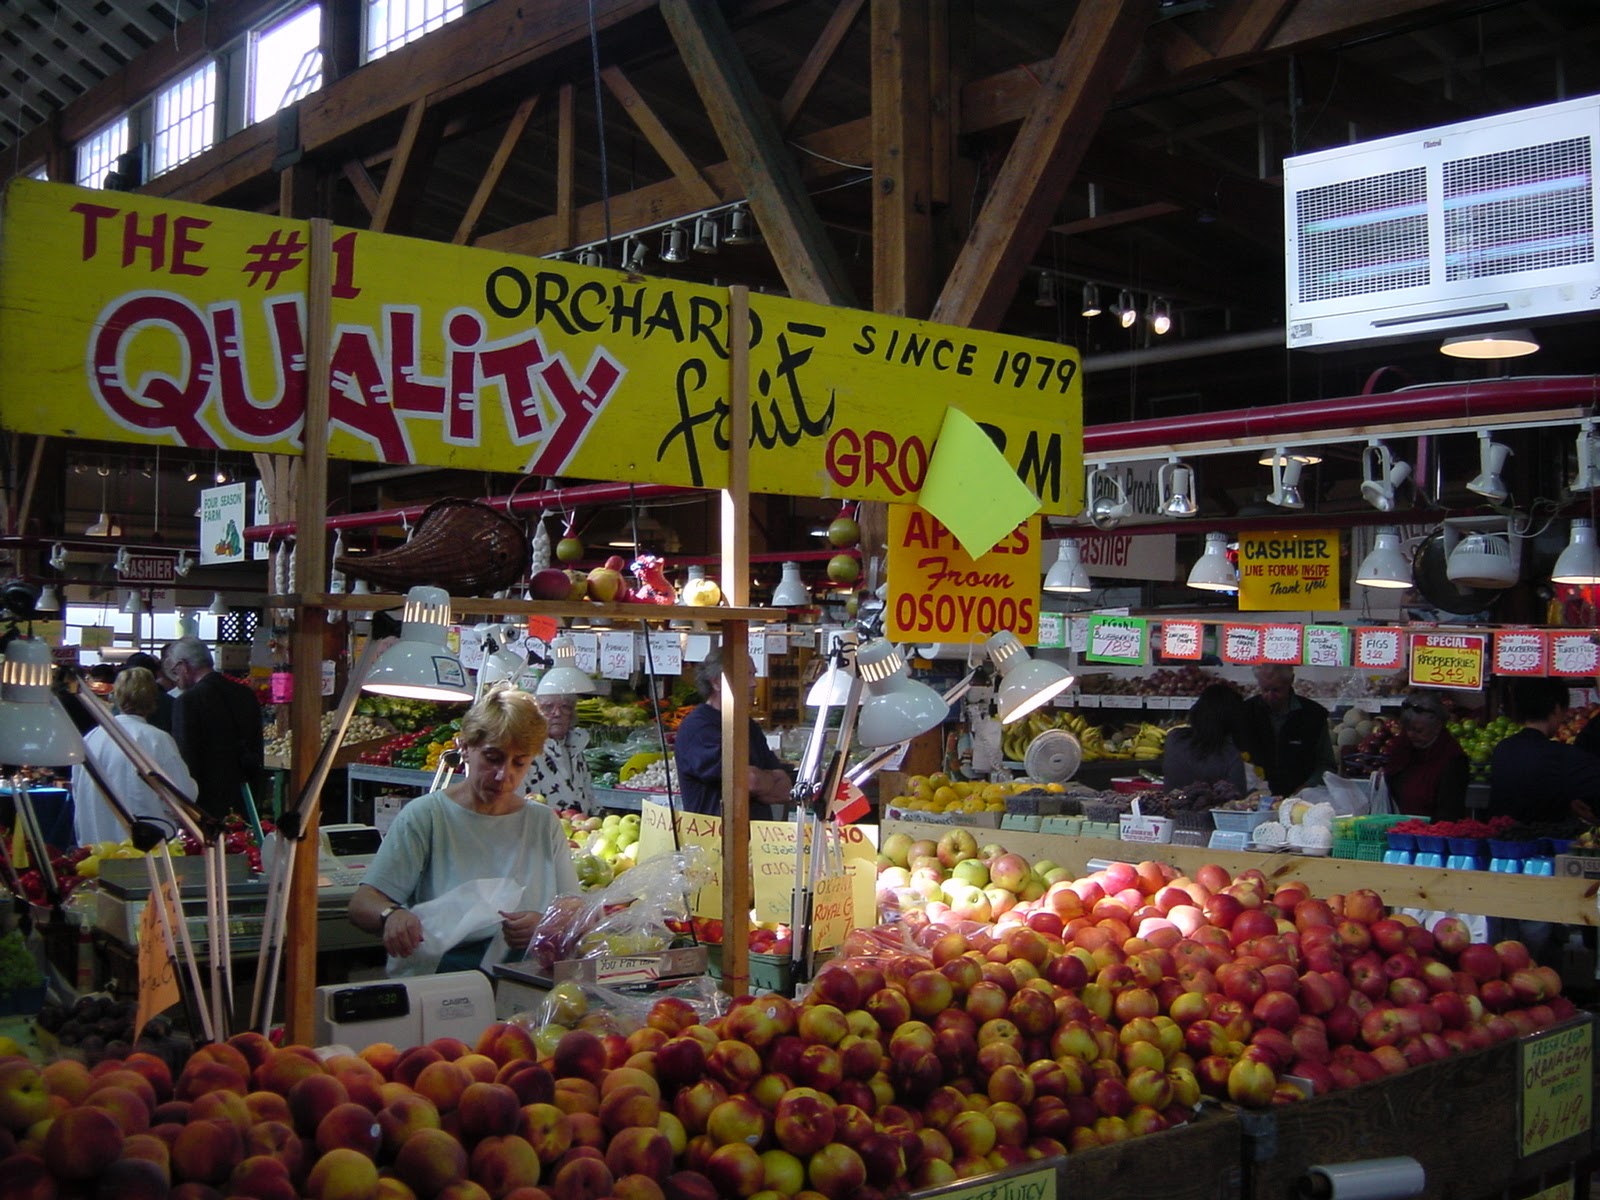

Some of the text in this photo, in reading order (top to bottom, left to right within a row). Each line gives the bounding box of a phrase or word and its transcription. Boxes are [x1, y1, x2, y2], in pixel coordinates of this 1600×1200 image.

[70, 202, 213, 277] THE
[487, 266, 763, 360] ORCHARD
[854, 325, 1076, 394] SINCE 1979
[204, 492, 242, 510] FOUR SEASON
[204, 508, 222, 523] FARM
[1080, 536, 1133, 567] ashier
[1244, 538, 1331, 560] CASHIER
[917, 556, 1015, 592] From
[1244, 564, 1330, 577] LINE FORMS INSIDE
[1270, 580, 1301, 595] Thank
[895, 593, 1034, 635] OSOYOOS
[1366, 639, 1389, 650] FIGS
[1426, 636, 1469, 648] SPECIAL
[1416, 655, 1476, 668] RASPBERRIES
[1525, 1045, 1591, 1089] OKANAGAN
